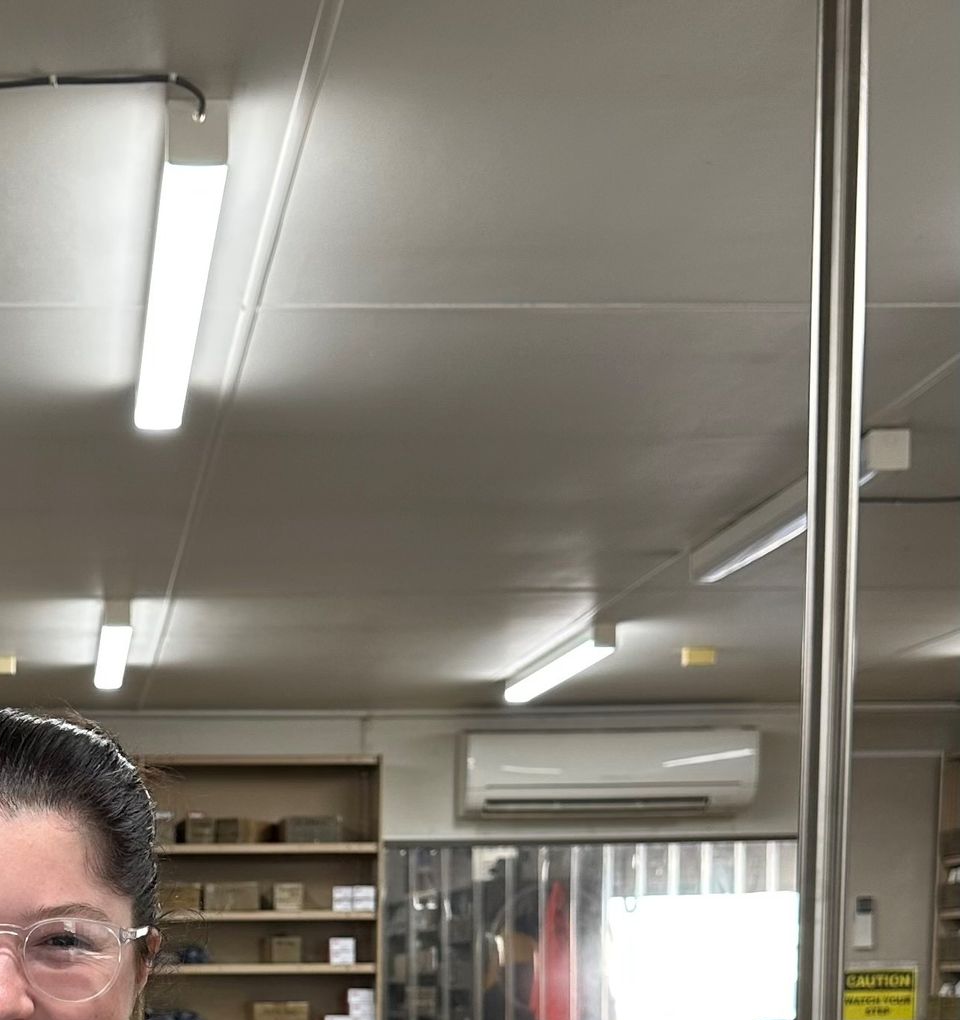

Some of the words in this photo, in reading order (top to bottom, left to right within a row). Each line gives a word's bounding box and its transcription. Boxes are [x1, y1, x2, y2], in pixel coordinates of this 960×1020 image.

[846, 974, 911, 988] CAUTION
[844, 996, 880, 1006] WATCH
[883, 995, 911, 1005] YOUR
